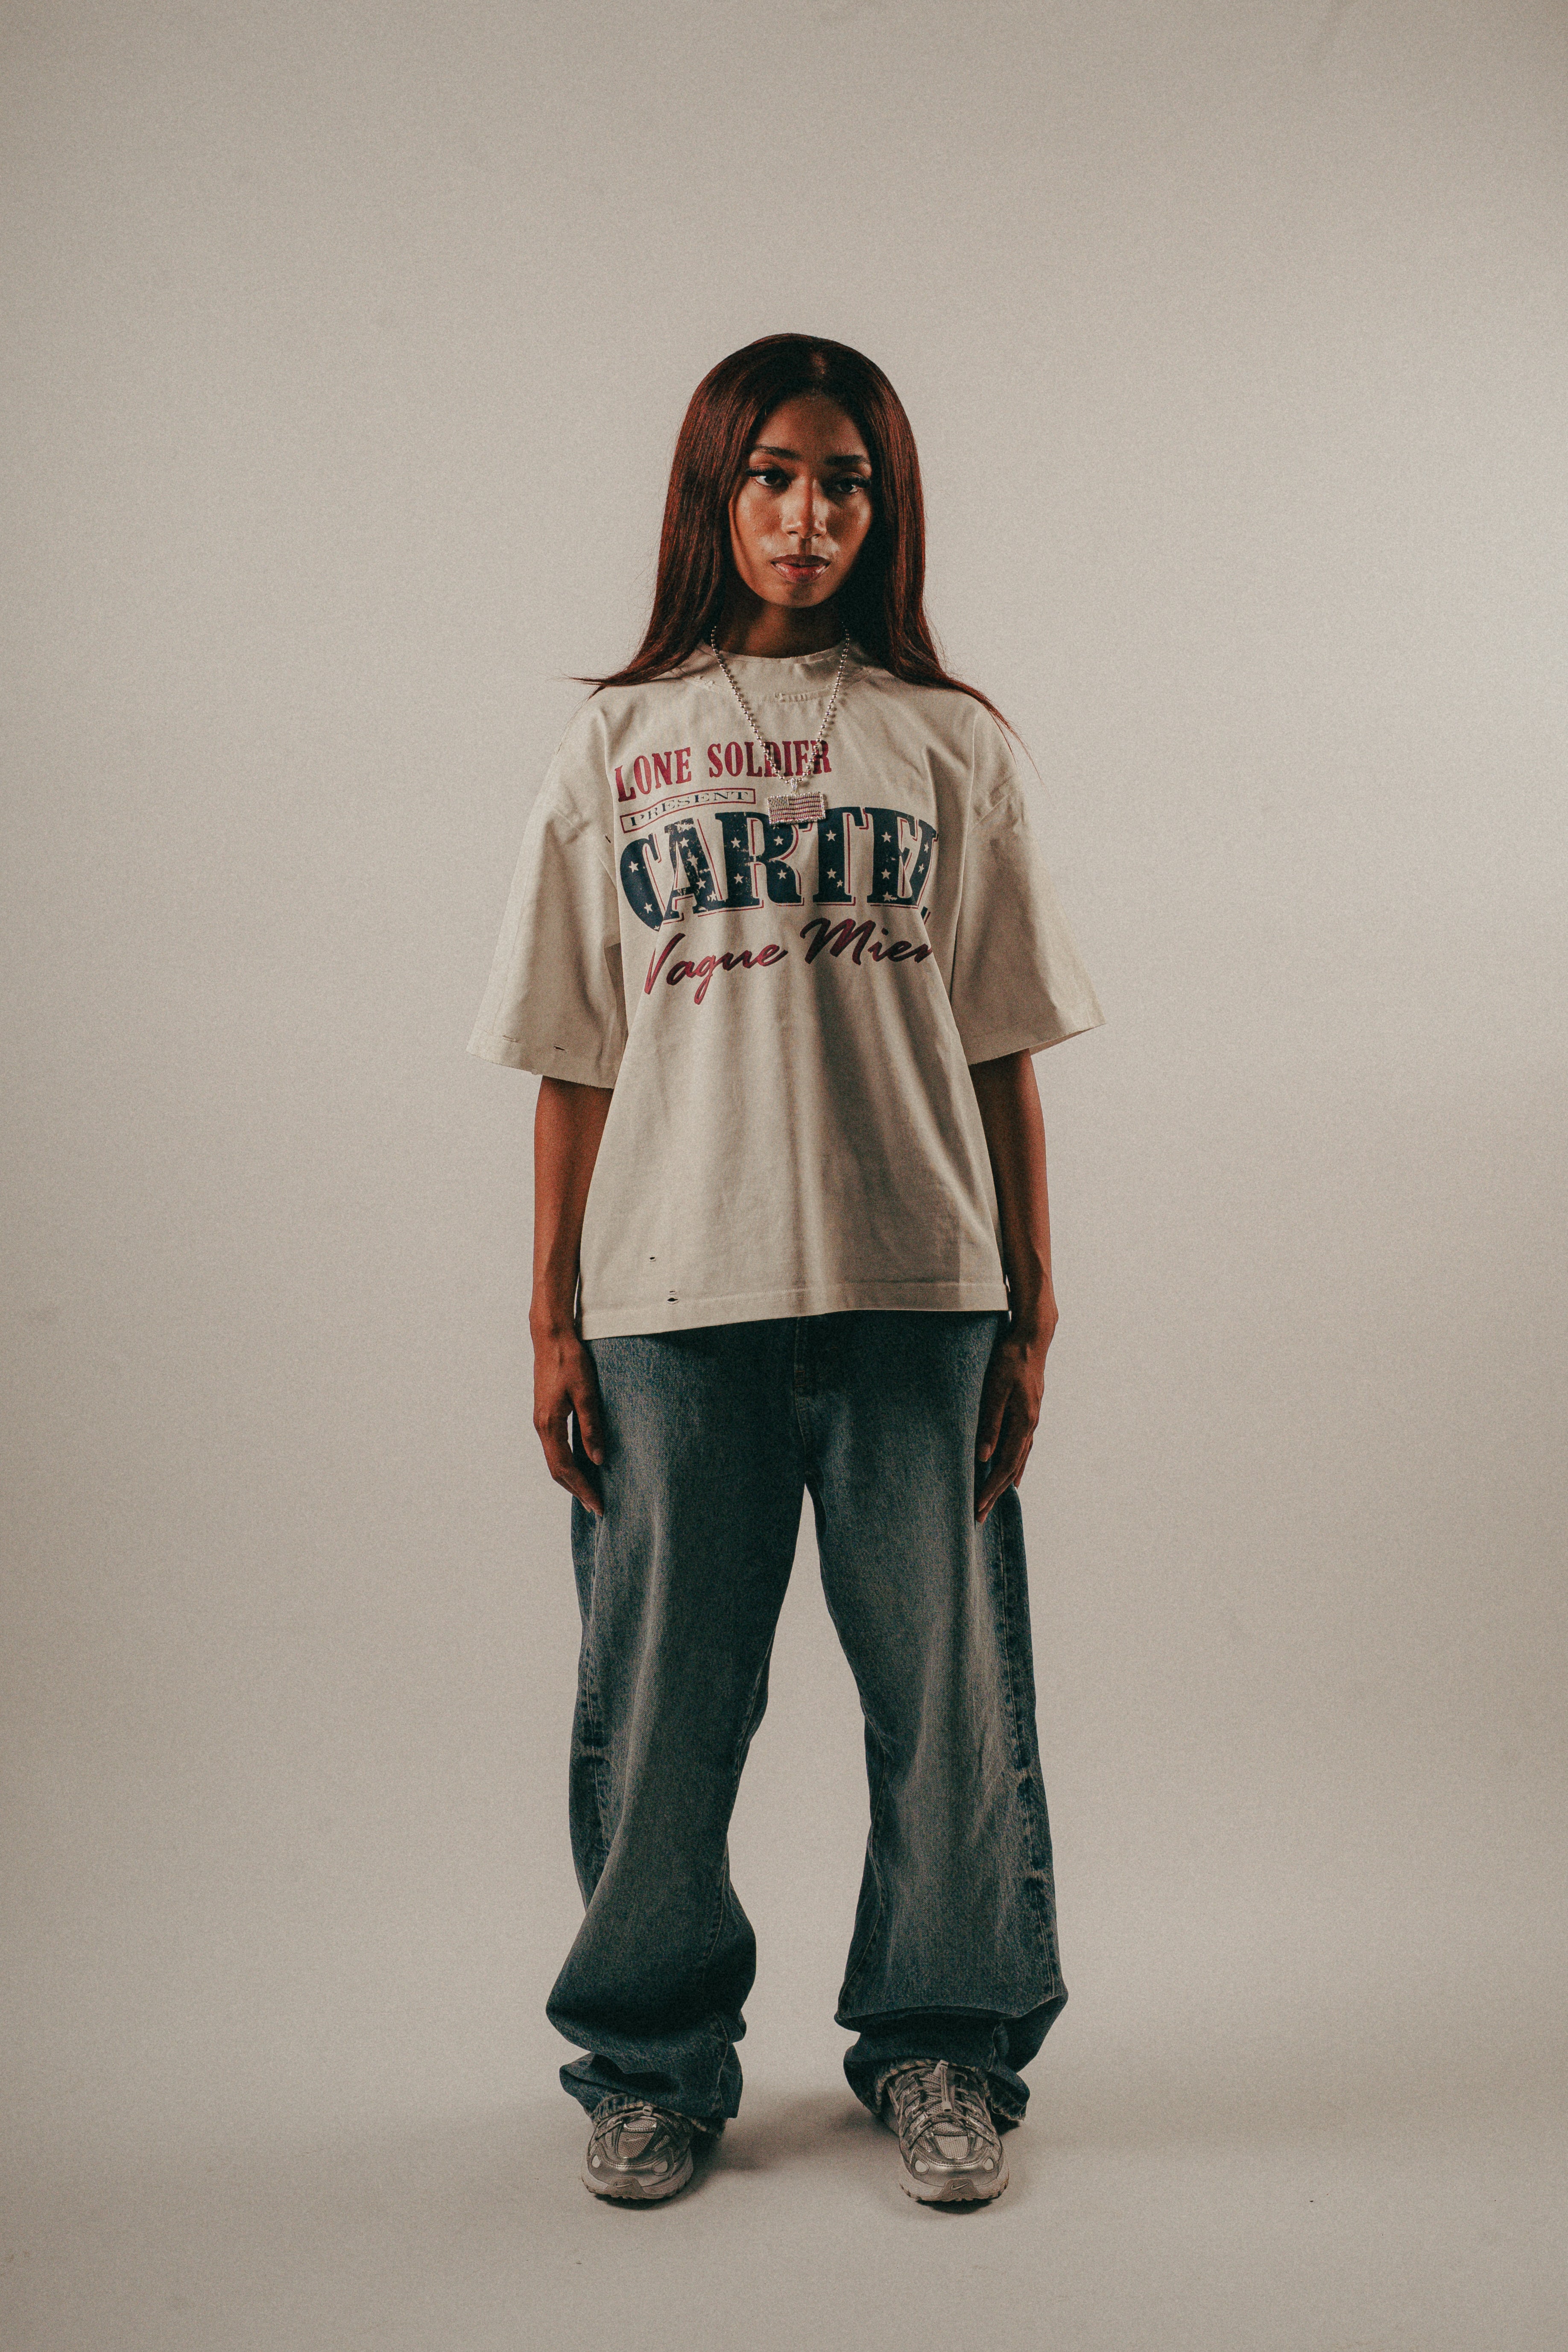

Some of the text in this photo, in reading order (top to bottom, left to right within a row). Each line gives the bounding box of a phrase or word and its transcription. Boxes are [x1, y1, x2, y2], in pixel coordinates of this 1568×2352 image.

[615, 740, 832, 802] LONE SOLDIER
[630, 791, 748, 827] PRESENT
[644, 933, 788, 1005] Vague
